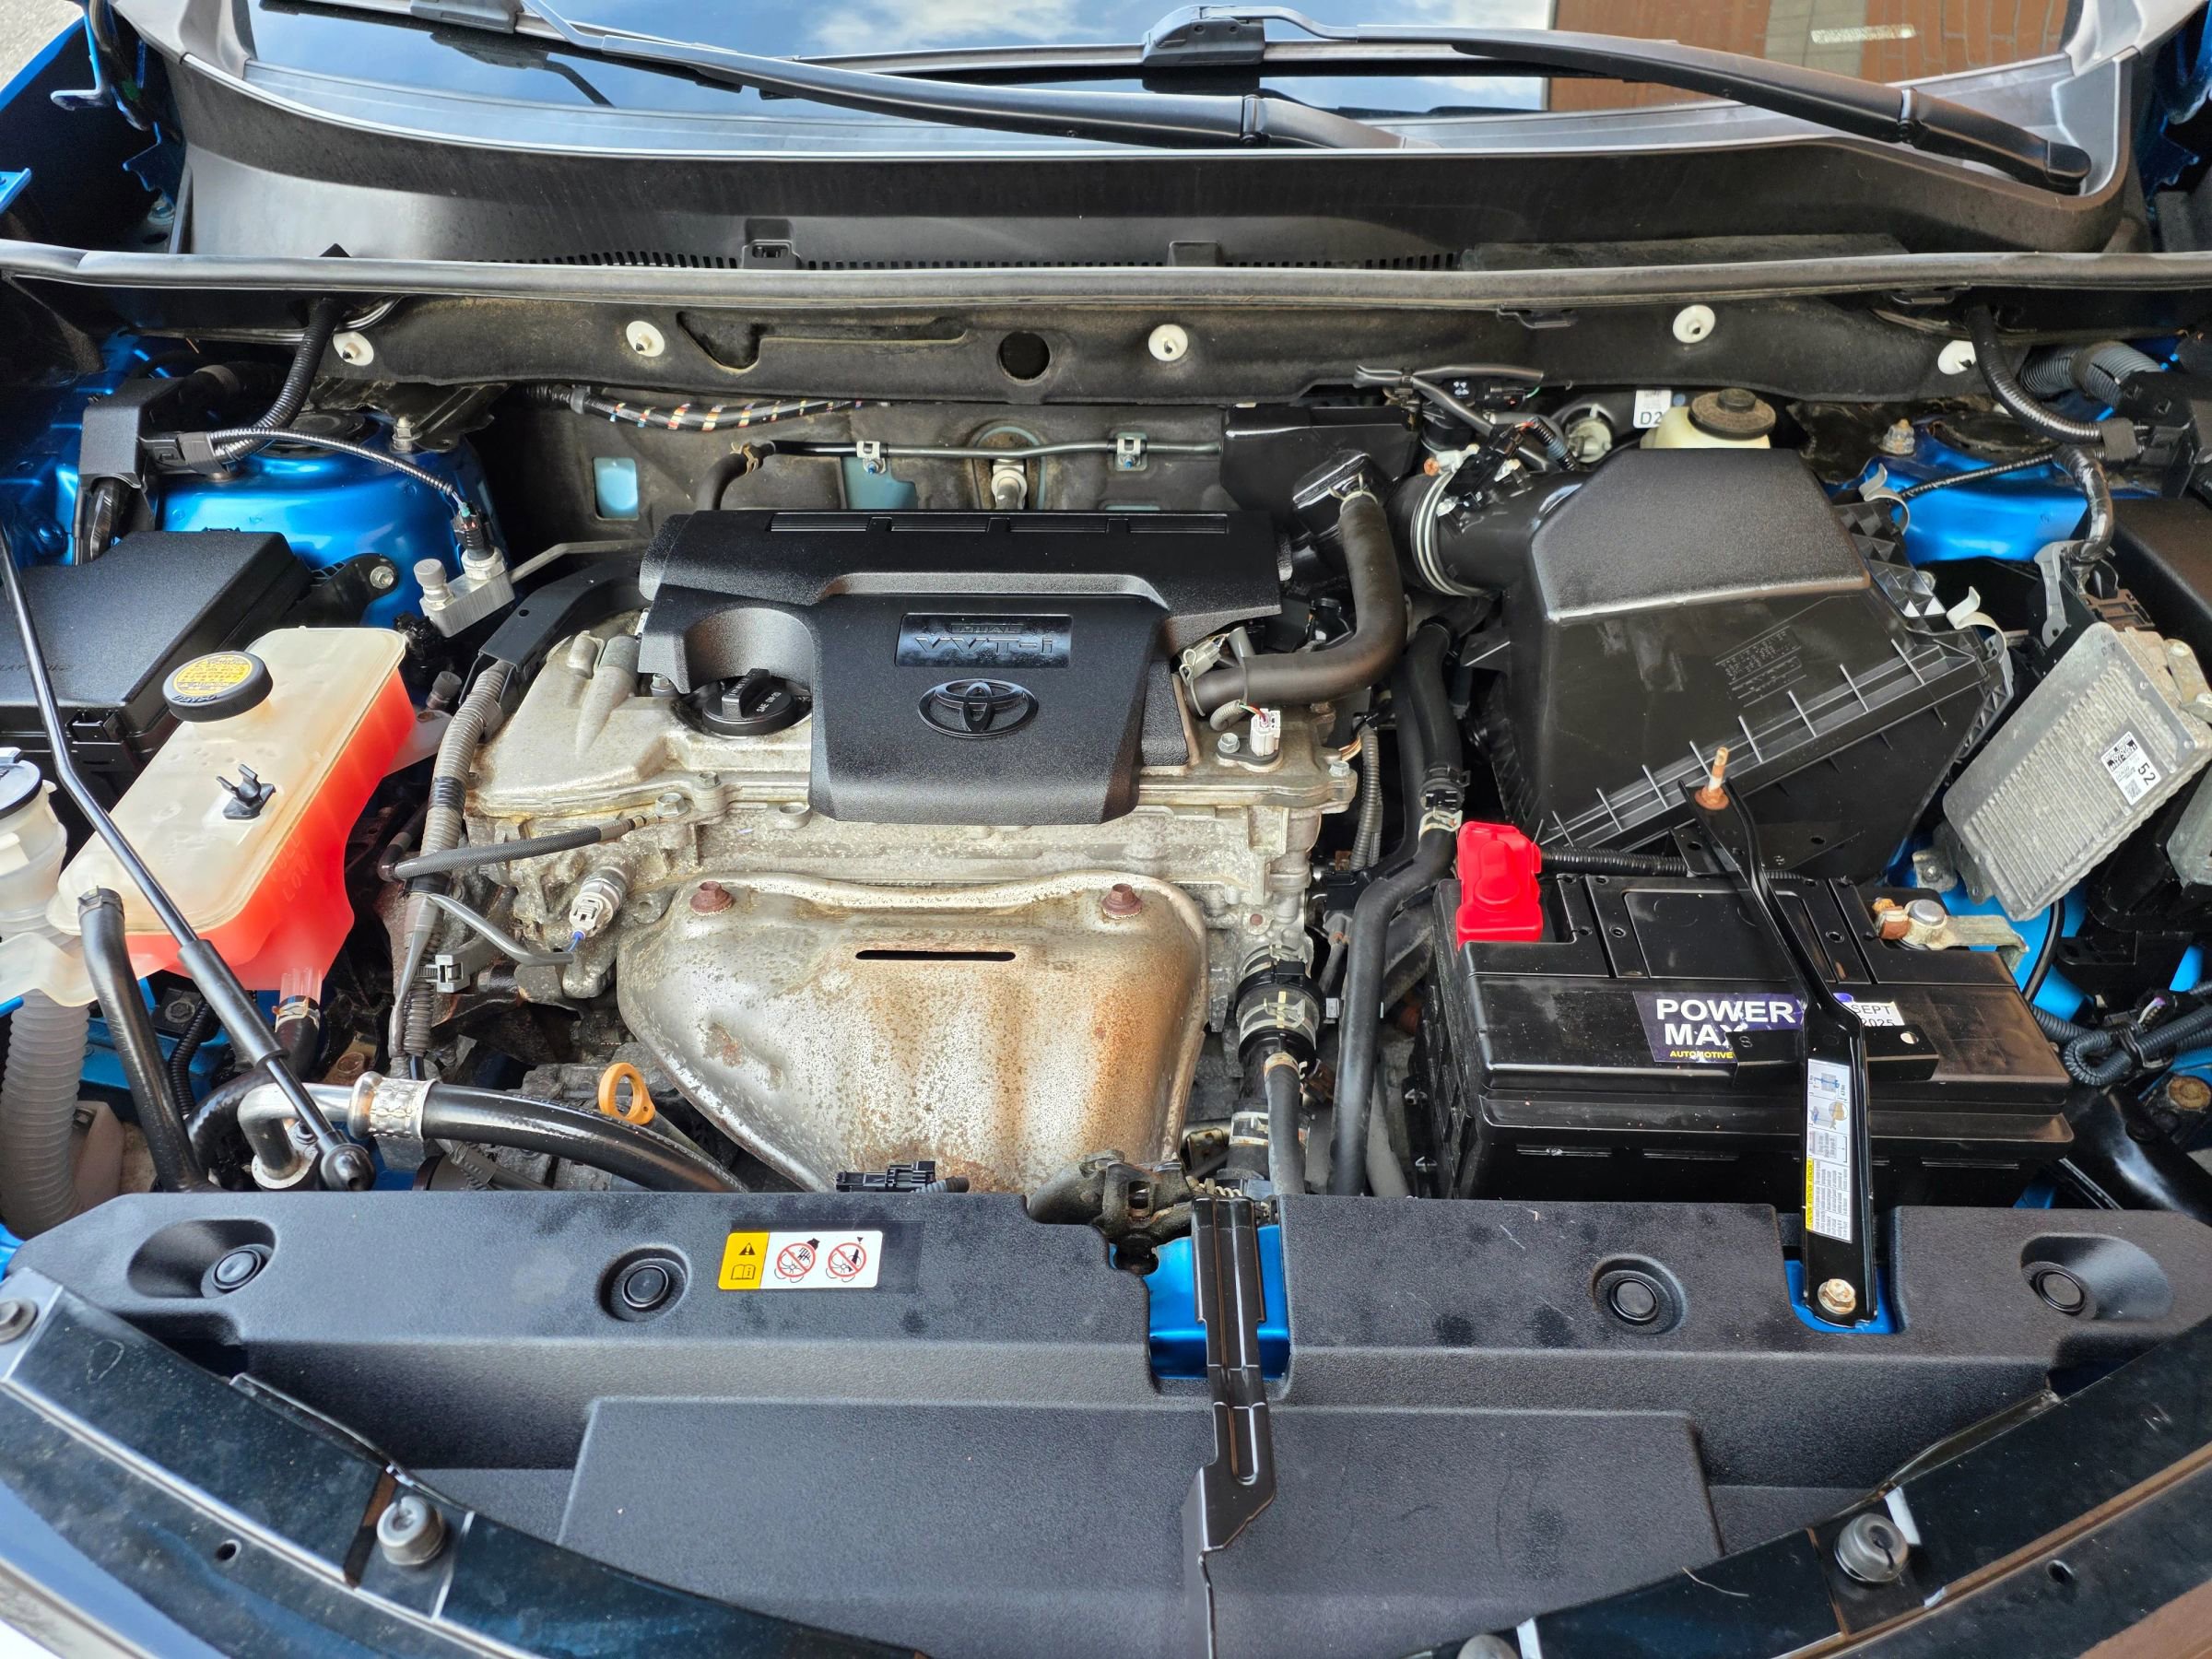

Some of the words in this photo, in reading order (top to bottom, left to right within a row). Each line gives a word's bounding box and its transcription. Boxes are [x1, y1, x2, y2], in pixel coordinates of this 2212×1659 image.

[959, 625, 1018, 633] DUAL
[915, 637, 1053, 653] VVT-i
[171, 695, 218, 703] DENSO
[756, 703, 770, 712] SAE
[2138, 762, 2156, 785] 52
[1656, 998, 1796, 1023] POWER
[1851, 1004, 1891, 1014] SEPT
[1861, 1018, 1896, 1027] 2025
[1669, 1051, 1734, 1059] AUTOMOTIVE
